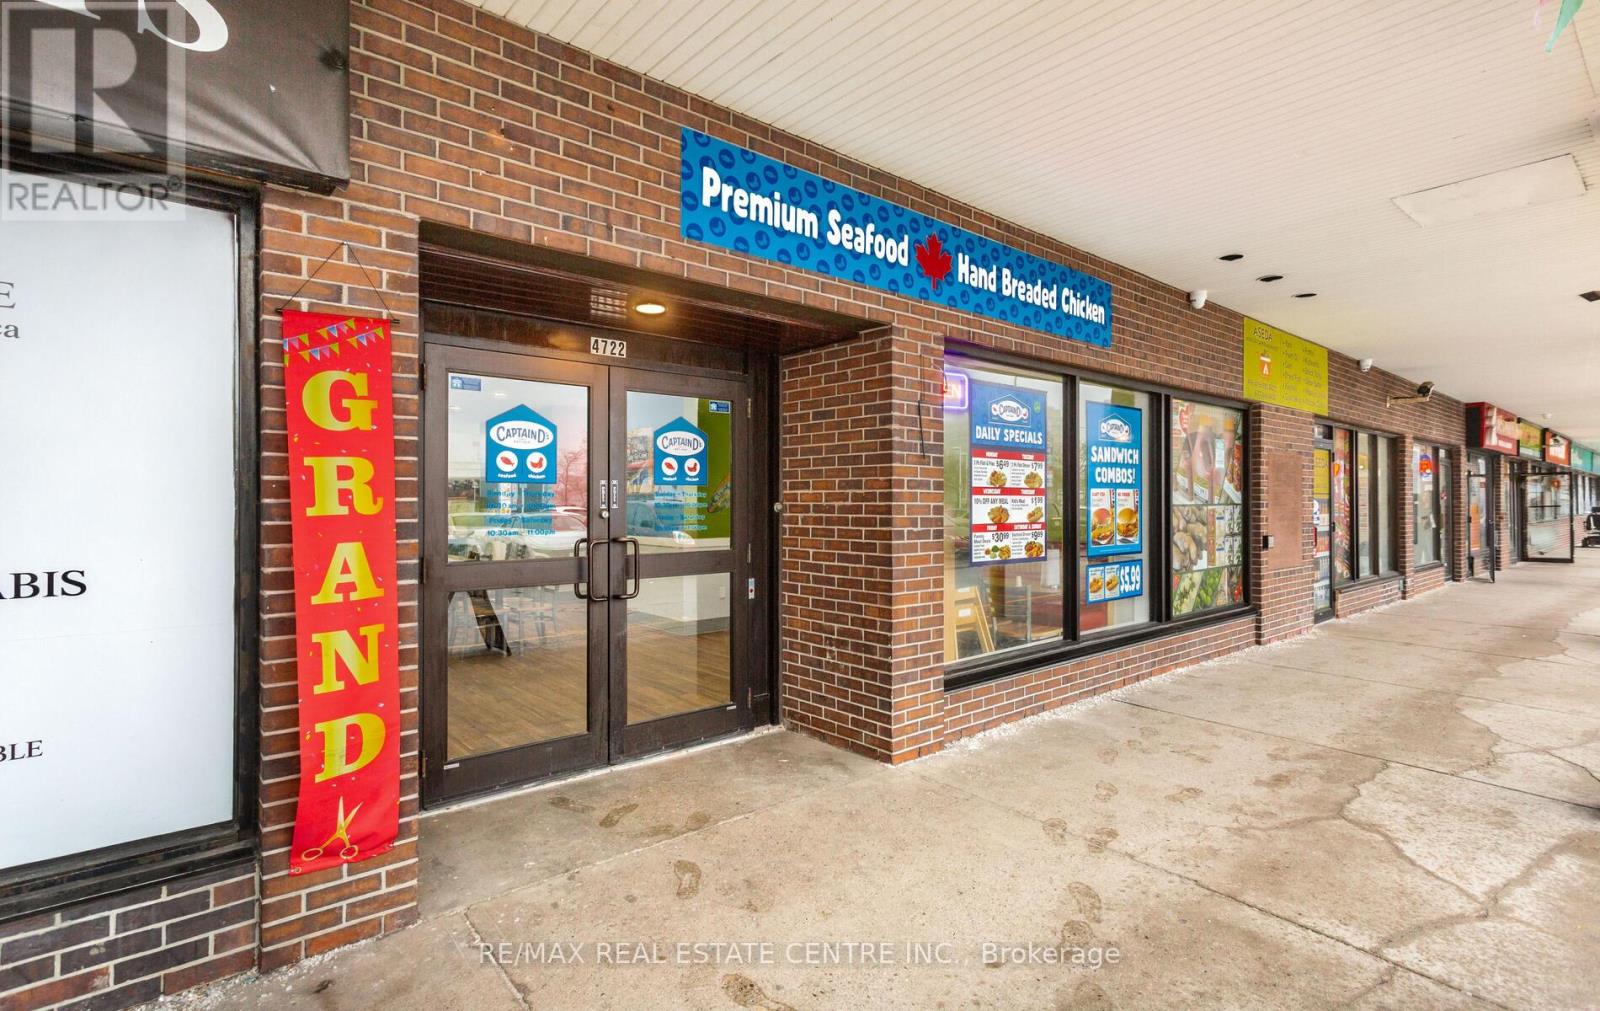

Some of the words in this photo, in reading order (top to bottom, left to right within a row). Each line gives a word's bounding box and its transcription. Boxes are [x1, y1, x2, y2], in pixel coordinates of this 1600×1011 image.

[702, 166, 819, 239] Premium
[827, 209, 909, 267] Seafood
[957, 252, 997, 293] Hand
[1002, 267, 1058, 310] Breaded
[1061, 287, 1105, 325] Chicken
[592, 338, 625, 357] 4722
[975, 425, 1001, 441] DAILY
[1003, 428, 1043, 445] SPECIALS
[1090, 445, 1139, 465] SANDWICH
[1095, 466, 1136, 484] COMBOS!
[302, 369, 386, 784] GRAND
[1120, 564, 1141, 594] $5.99
